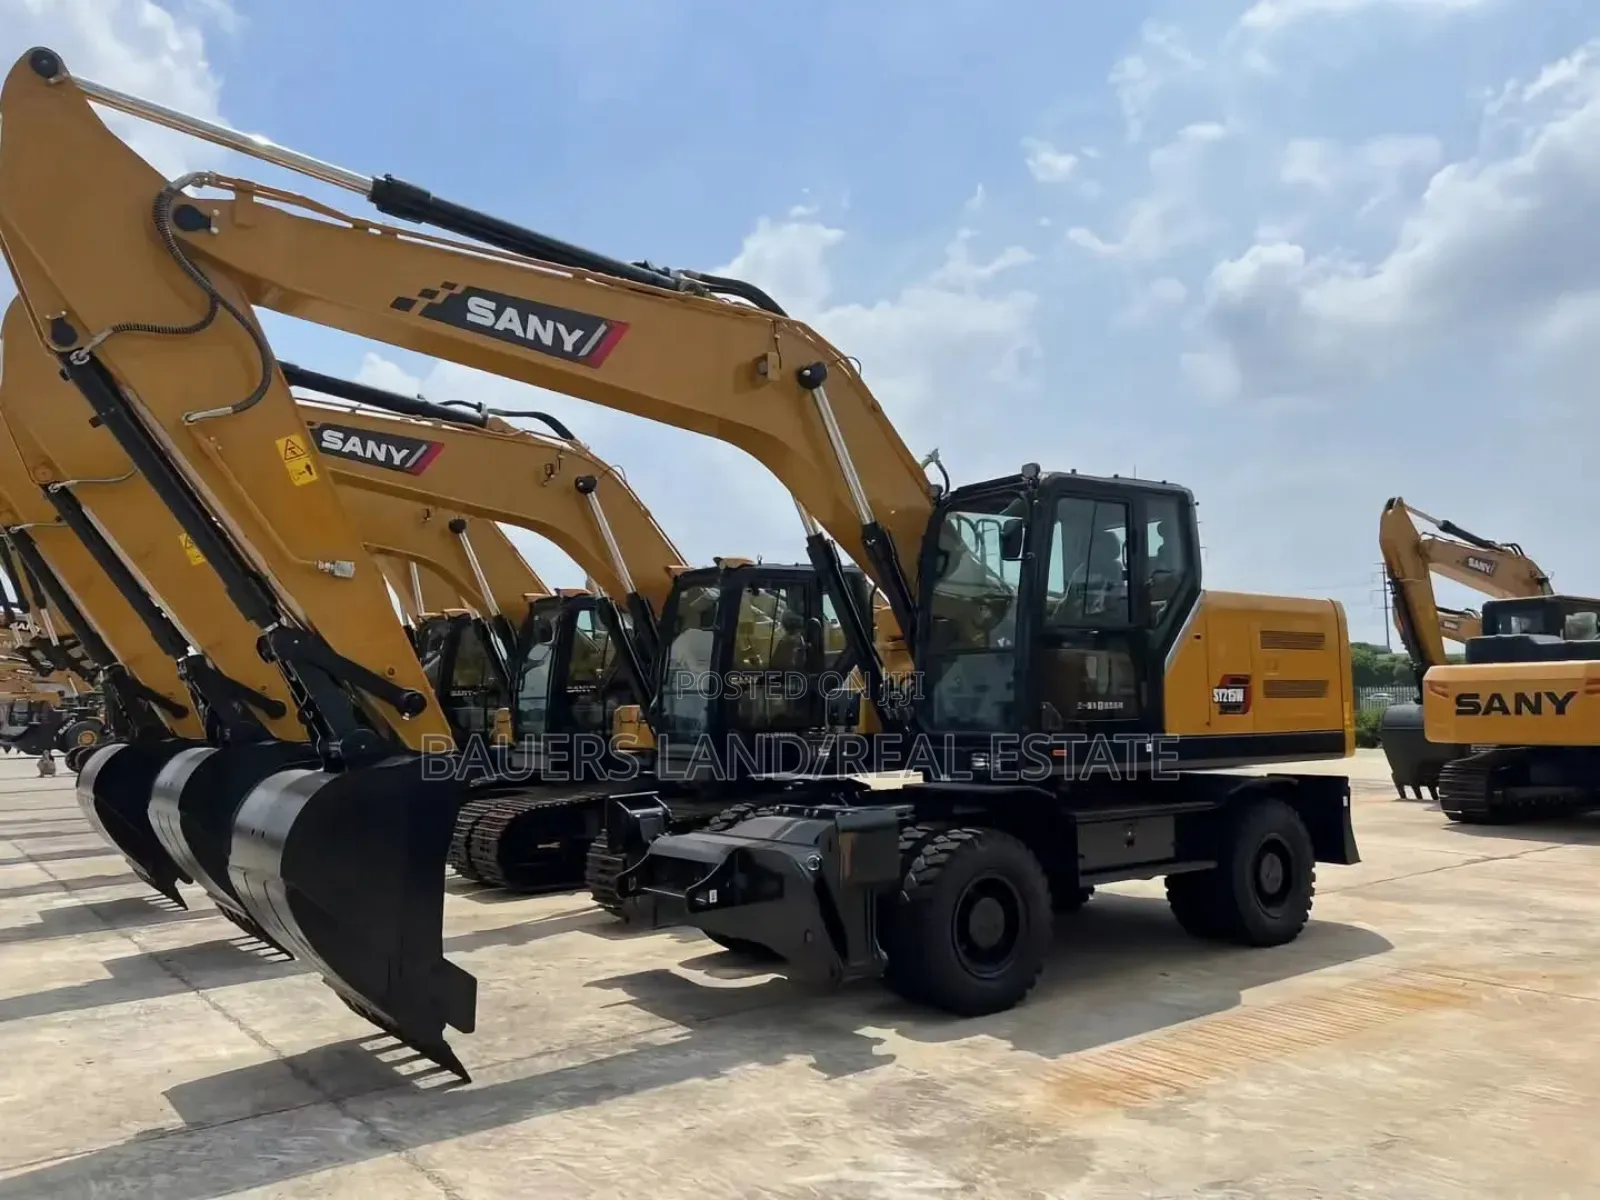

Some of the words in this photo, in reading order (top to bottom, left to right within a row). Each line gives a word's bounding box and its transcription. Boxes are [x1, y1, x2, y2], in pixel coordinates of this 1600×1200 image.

[466, 296, 584, 353] SANY
[321, 429, 410, 466] SANY
[1468, 556, 1492, 574] SANY
[1455, 691, 1578, 716] SANY
